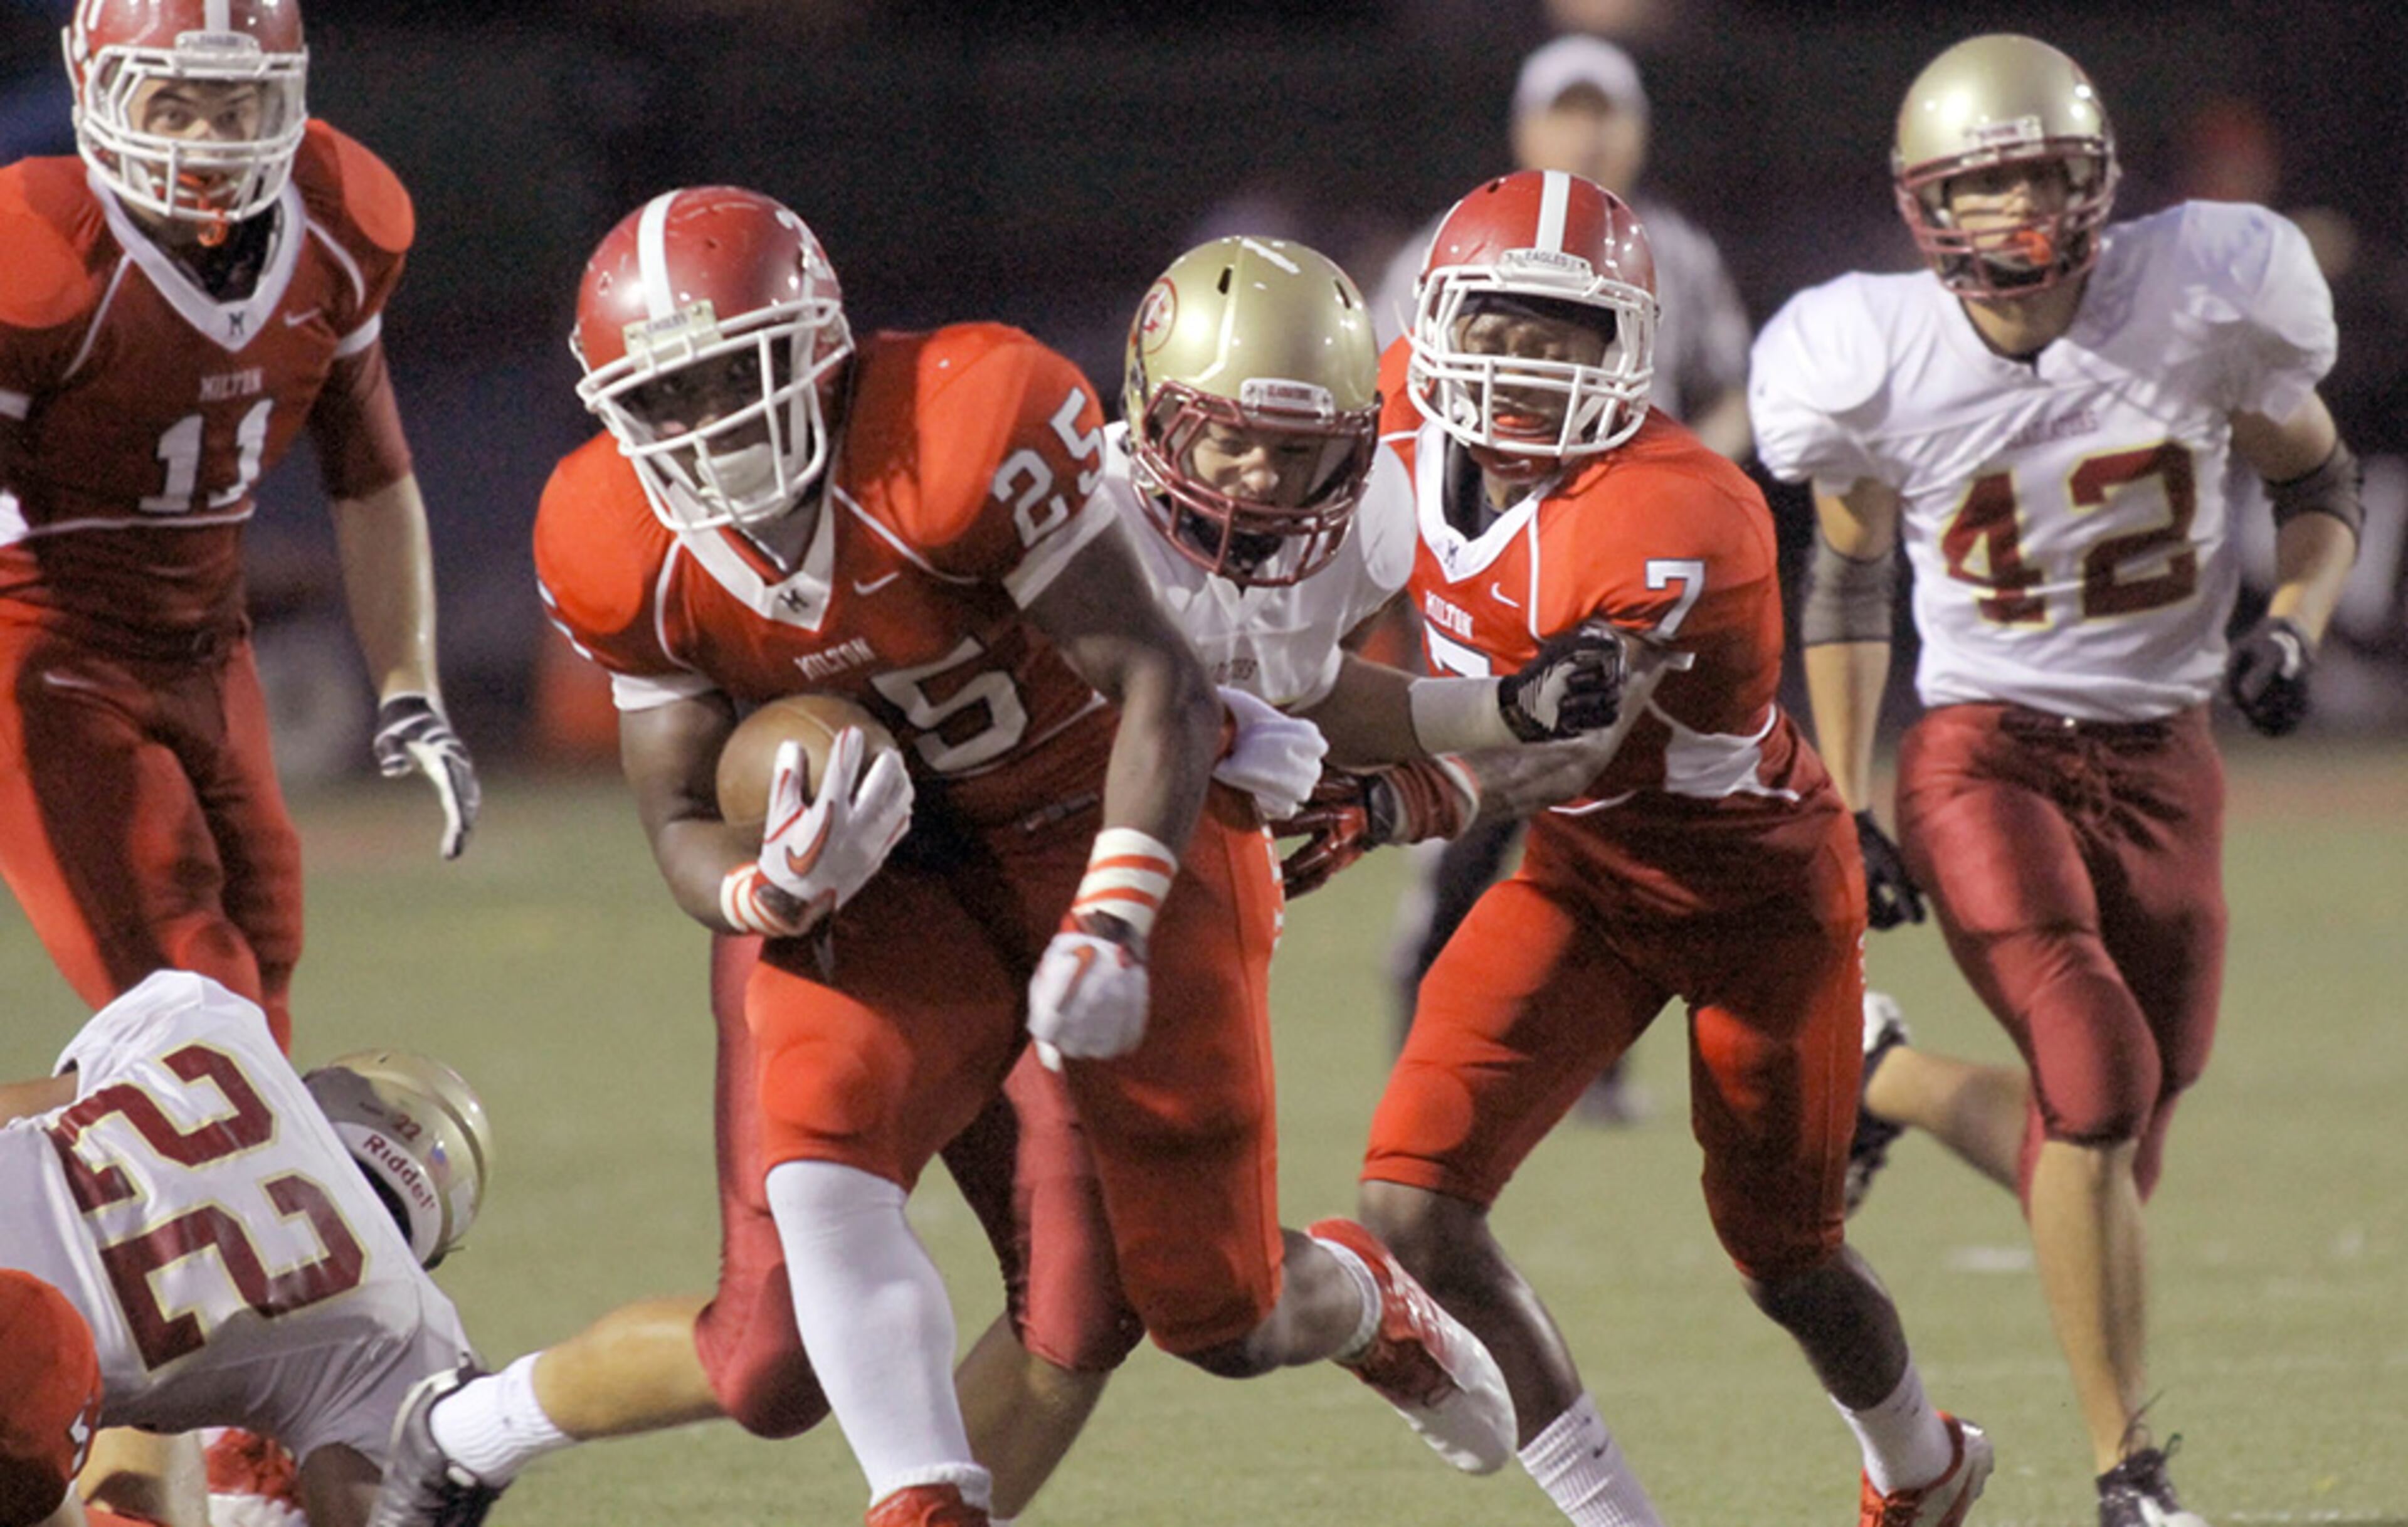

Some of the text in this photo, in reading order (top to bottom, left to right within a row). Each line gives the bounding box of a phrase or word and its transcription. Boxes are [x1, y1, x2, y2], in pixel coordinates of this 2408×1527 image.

[229, 310, 245, 336] M
[199, 367, 262, 400] MILTON
[139, 398, 273, 513] 11
[991, 387, 1104, 547] 25
[1940, 439, 2200, 629] 42
[1645, 558, 1706, 642] 7
[794, 637, 875, 681] MILTON
[45, 1038, 366, 1373] 22
